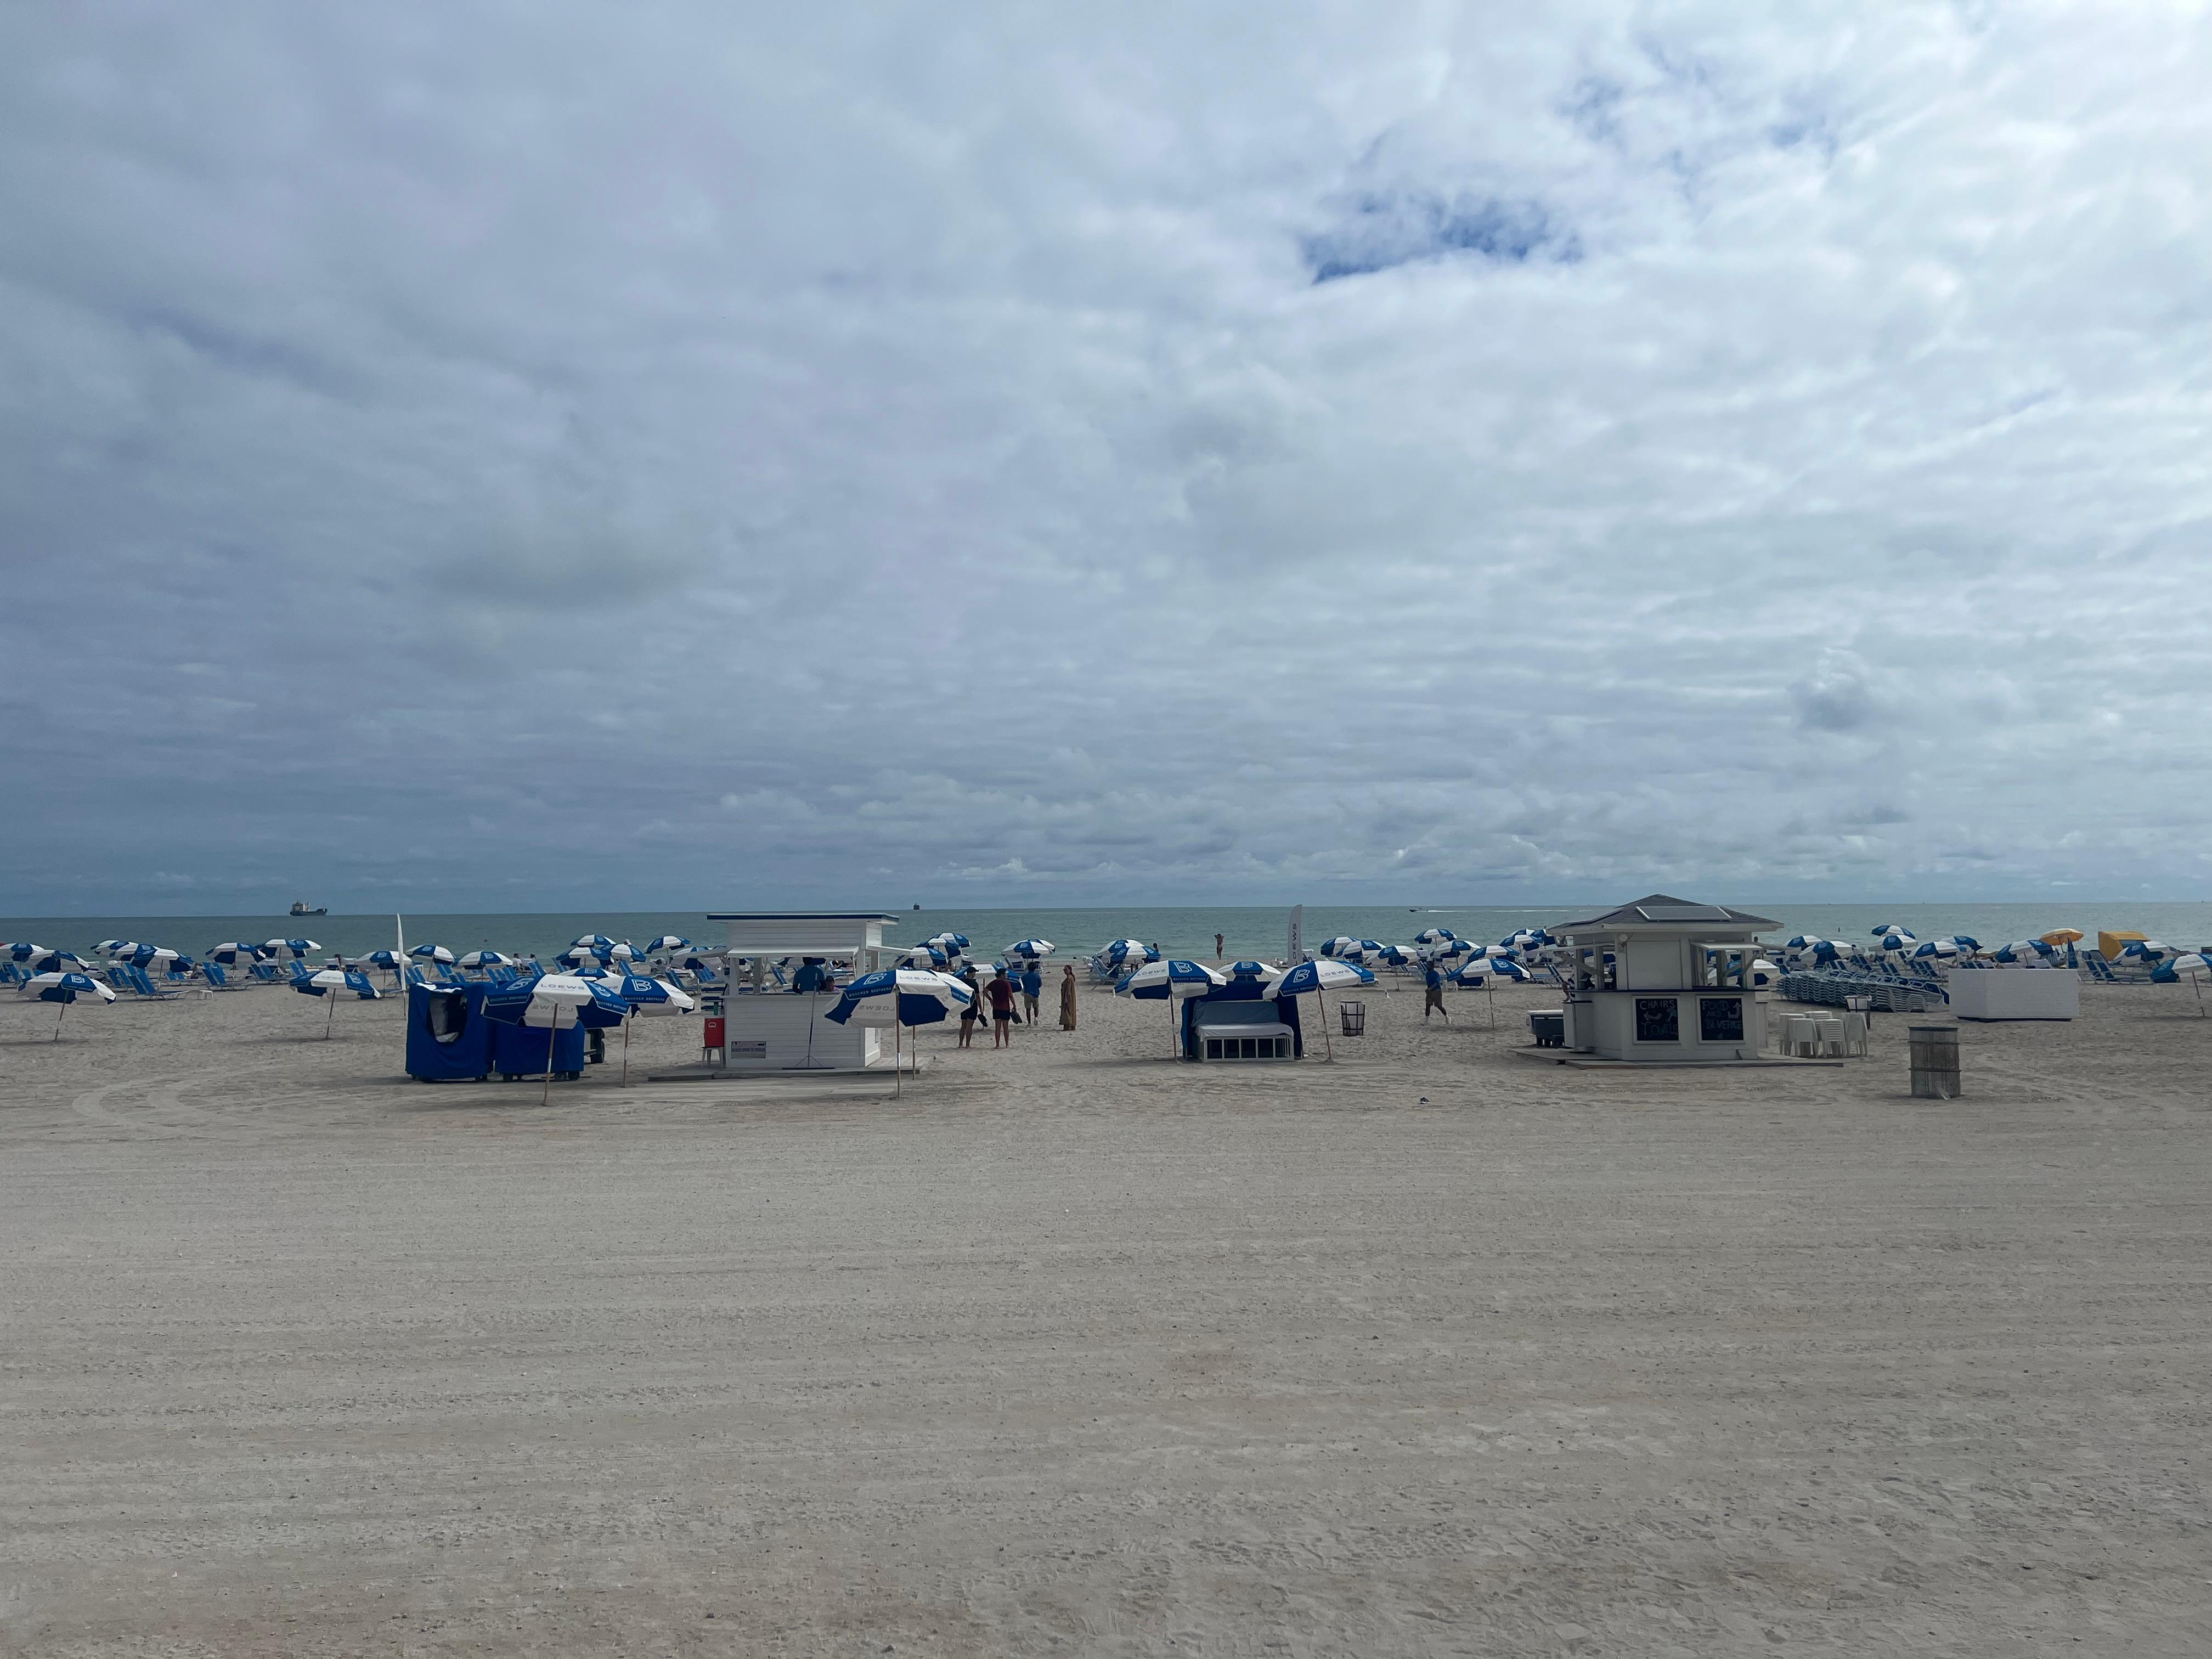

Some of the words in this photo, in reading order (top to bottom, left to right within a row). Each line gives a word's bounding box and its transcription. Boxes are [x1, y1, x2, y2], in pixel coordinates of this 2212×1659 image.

[1137, 968, 1166, 977] LOEWS
[1640, 1000, 1675, 1009] CHAIRS
[1702, 1000, 1729, 1011] FOOD
